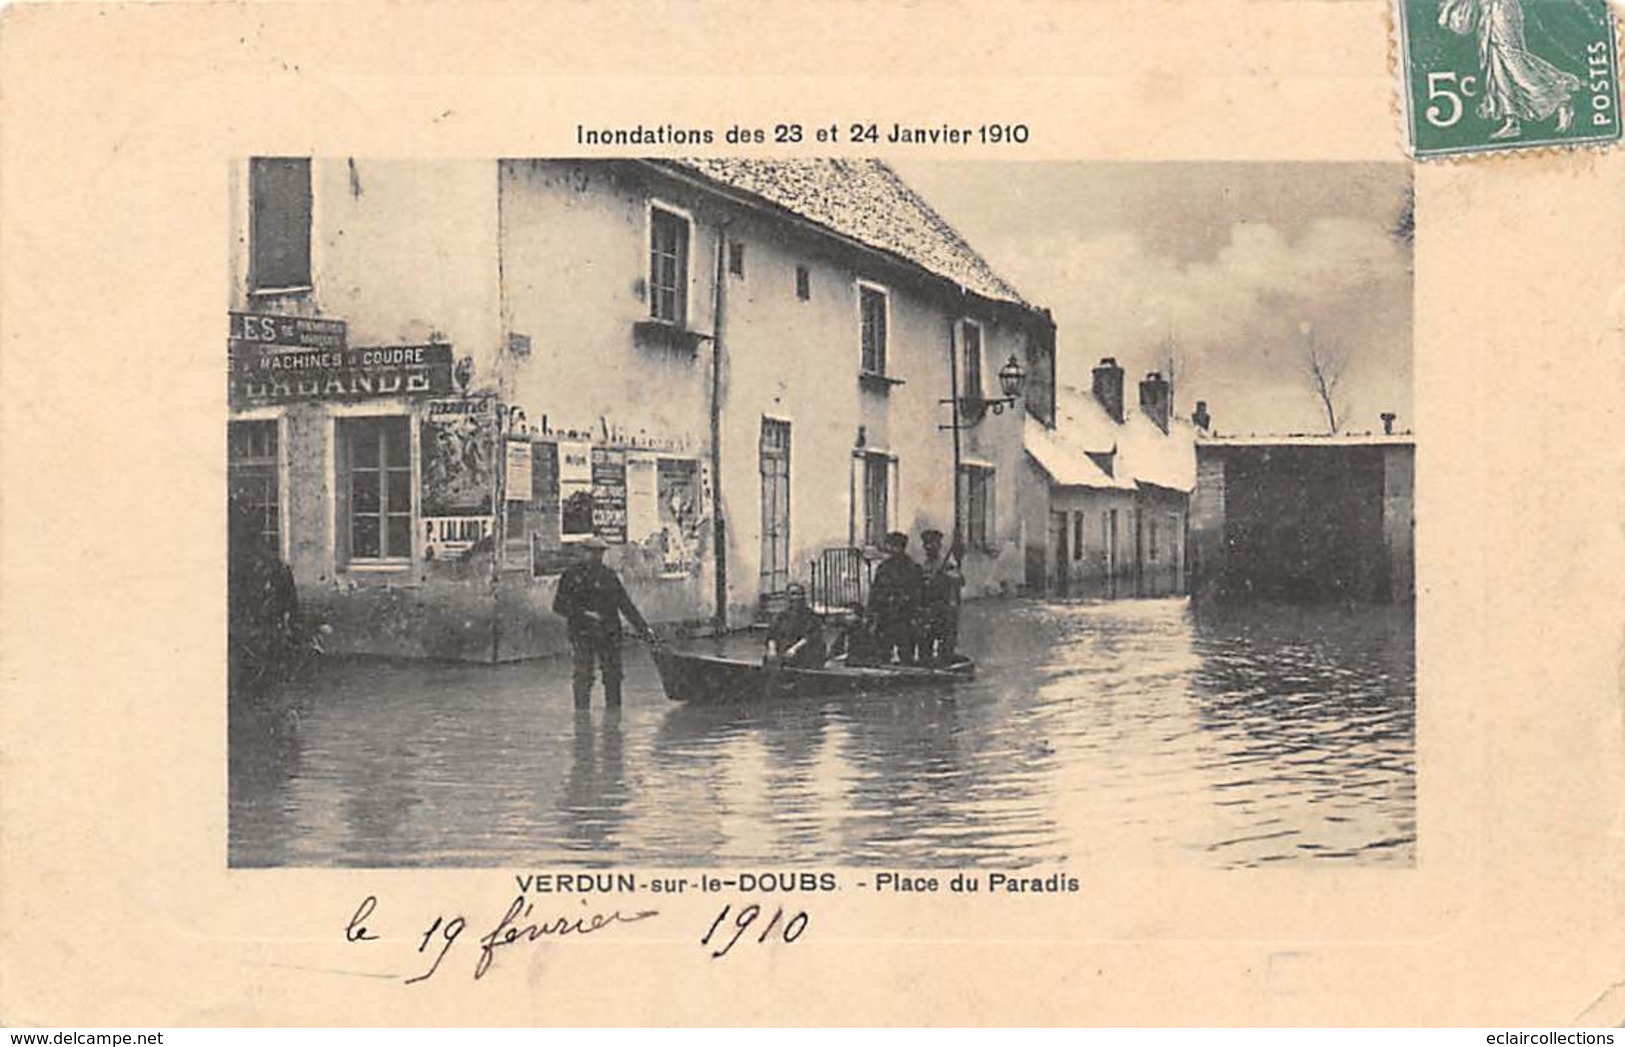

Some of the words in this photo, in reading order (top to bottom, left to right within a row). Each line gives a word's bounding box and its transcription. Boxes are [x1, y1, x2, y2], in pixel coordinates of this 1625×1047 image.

[1587, 41, 1612, 126] POSTES
[577, 124, 714, 145] Inondations
[726, 124, 765, 144] des
[774, 124, 803, 143] 23
[816, 124, 838, 143] et
[849, 123, 880, 144] 24
[887, 123, 973, 145] Janvier
[978, 124, 1029, 144] 1910
[259, 353, 342, 370] MACHINES
[363, 348, 425, 364] COUDRE
[876, 872, 940, 893] Place
[951, 872, 979, 893] du
[989, 872, 1080, 893] Paradis
[404, 915, 466, 985] 19
[701, 904, 809, 959] 1910
